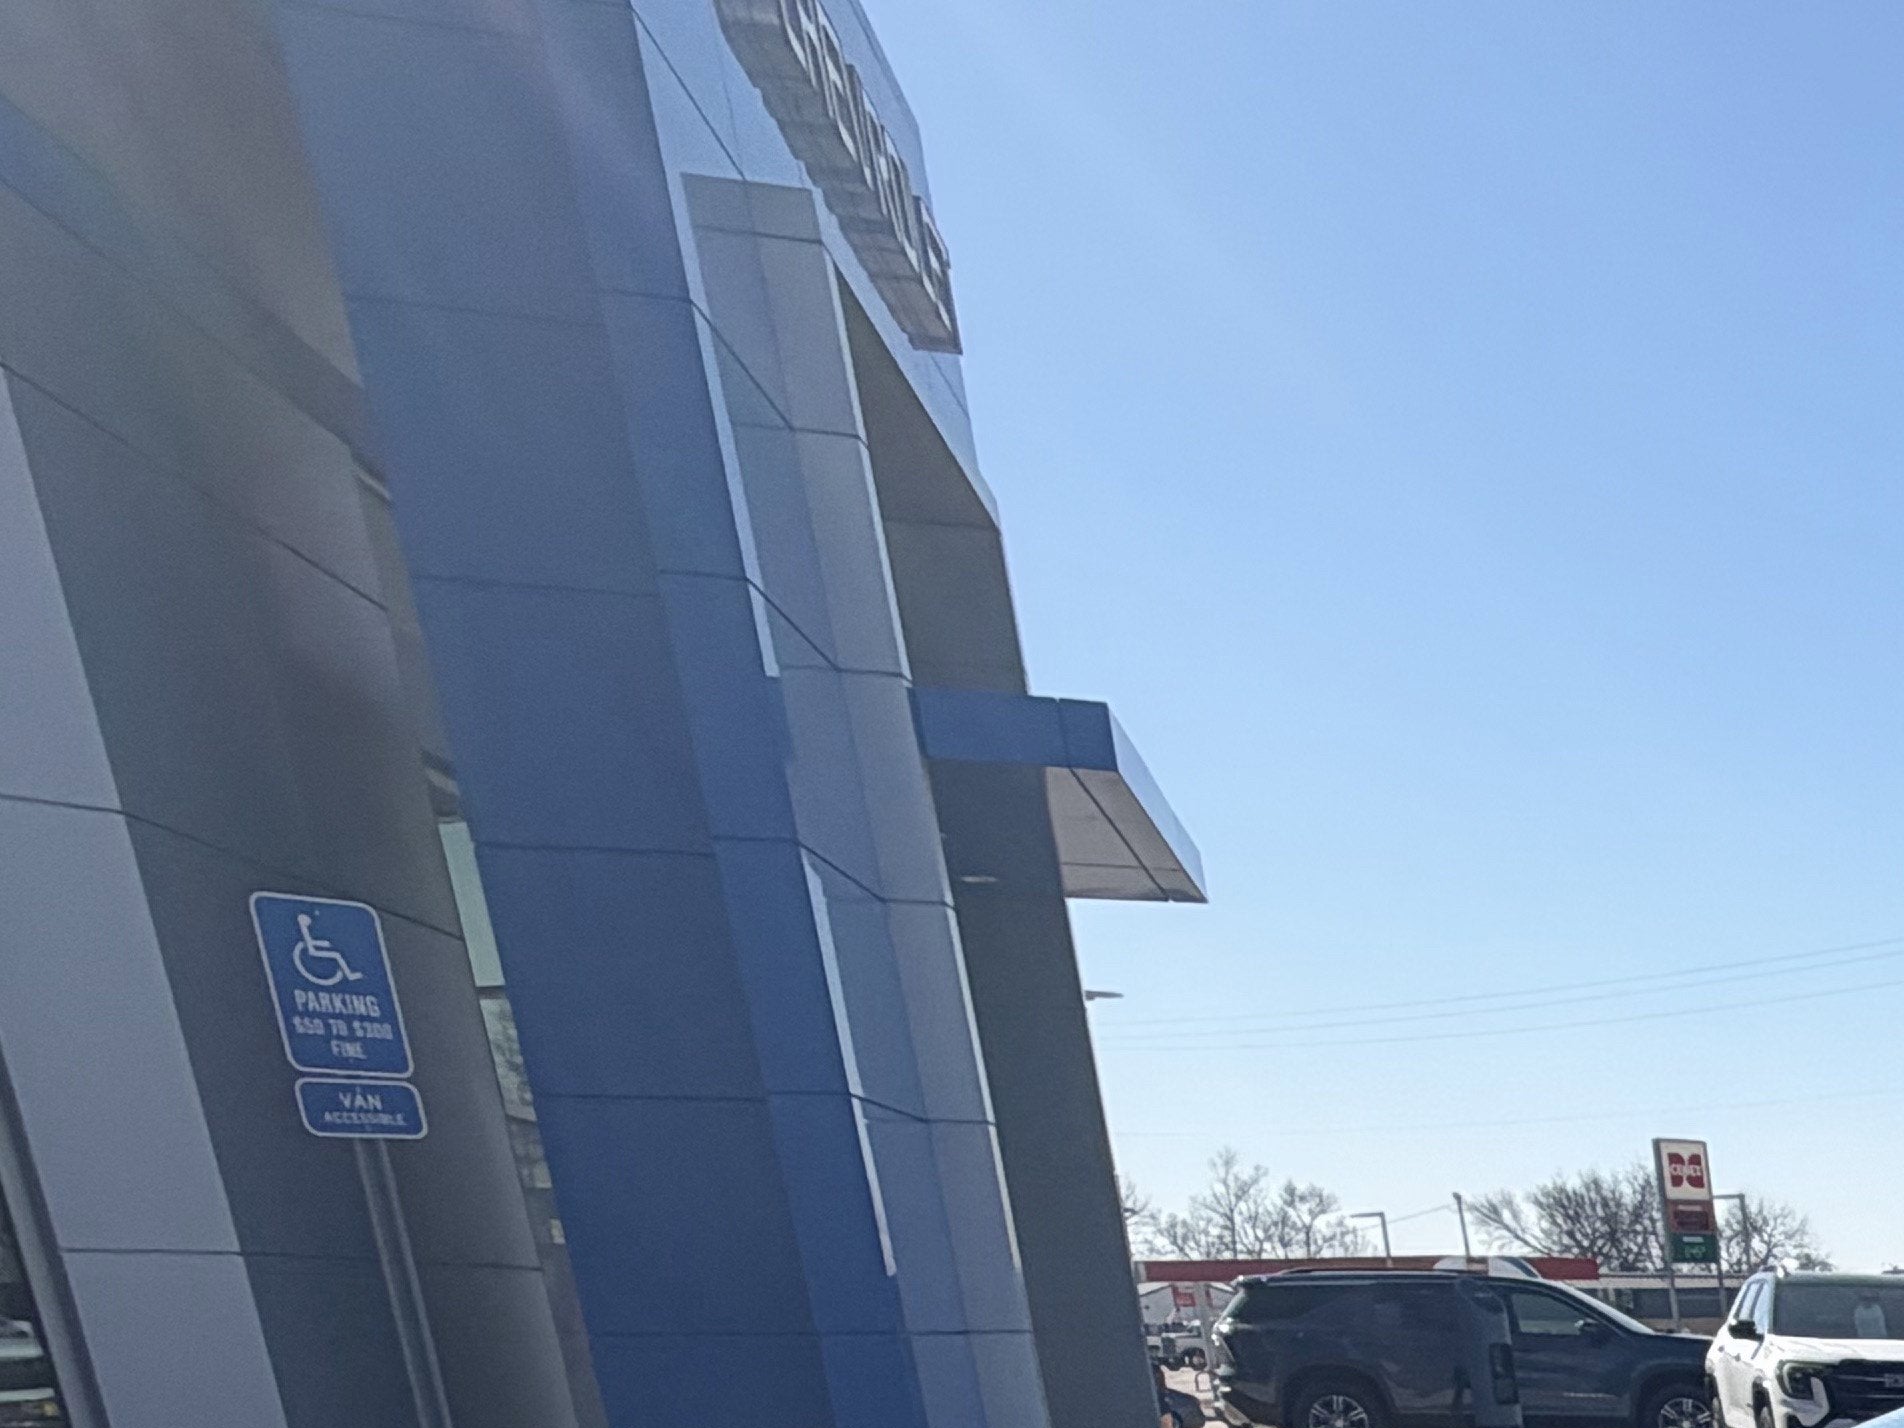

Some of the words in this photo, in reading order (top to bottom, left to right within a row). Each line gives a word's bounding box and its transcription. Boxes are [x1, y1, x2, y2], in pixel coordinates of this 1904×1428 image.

[294, 989, 381, 1017] PARKING
[328, 1019, 348, 1037] TO
[330, 1040, 368, 1060] FINE
[339, 1091, 383, 1110] VAN
